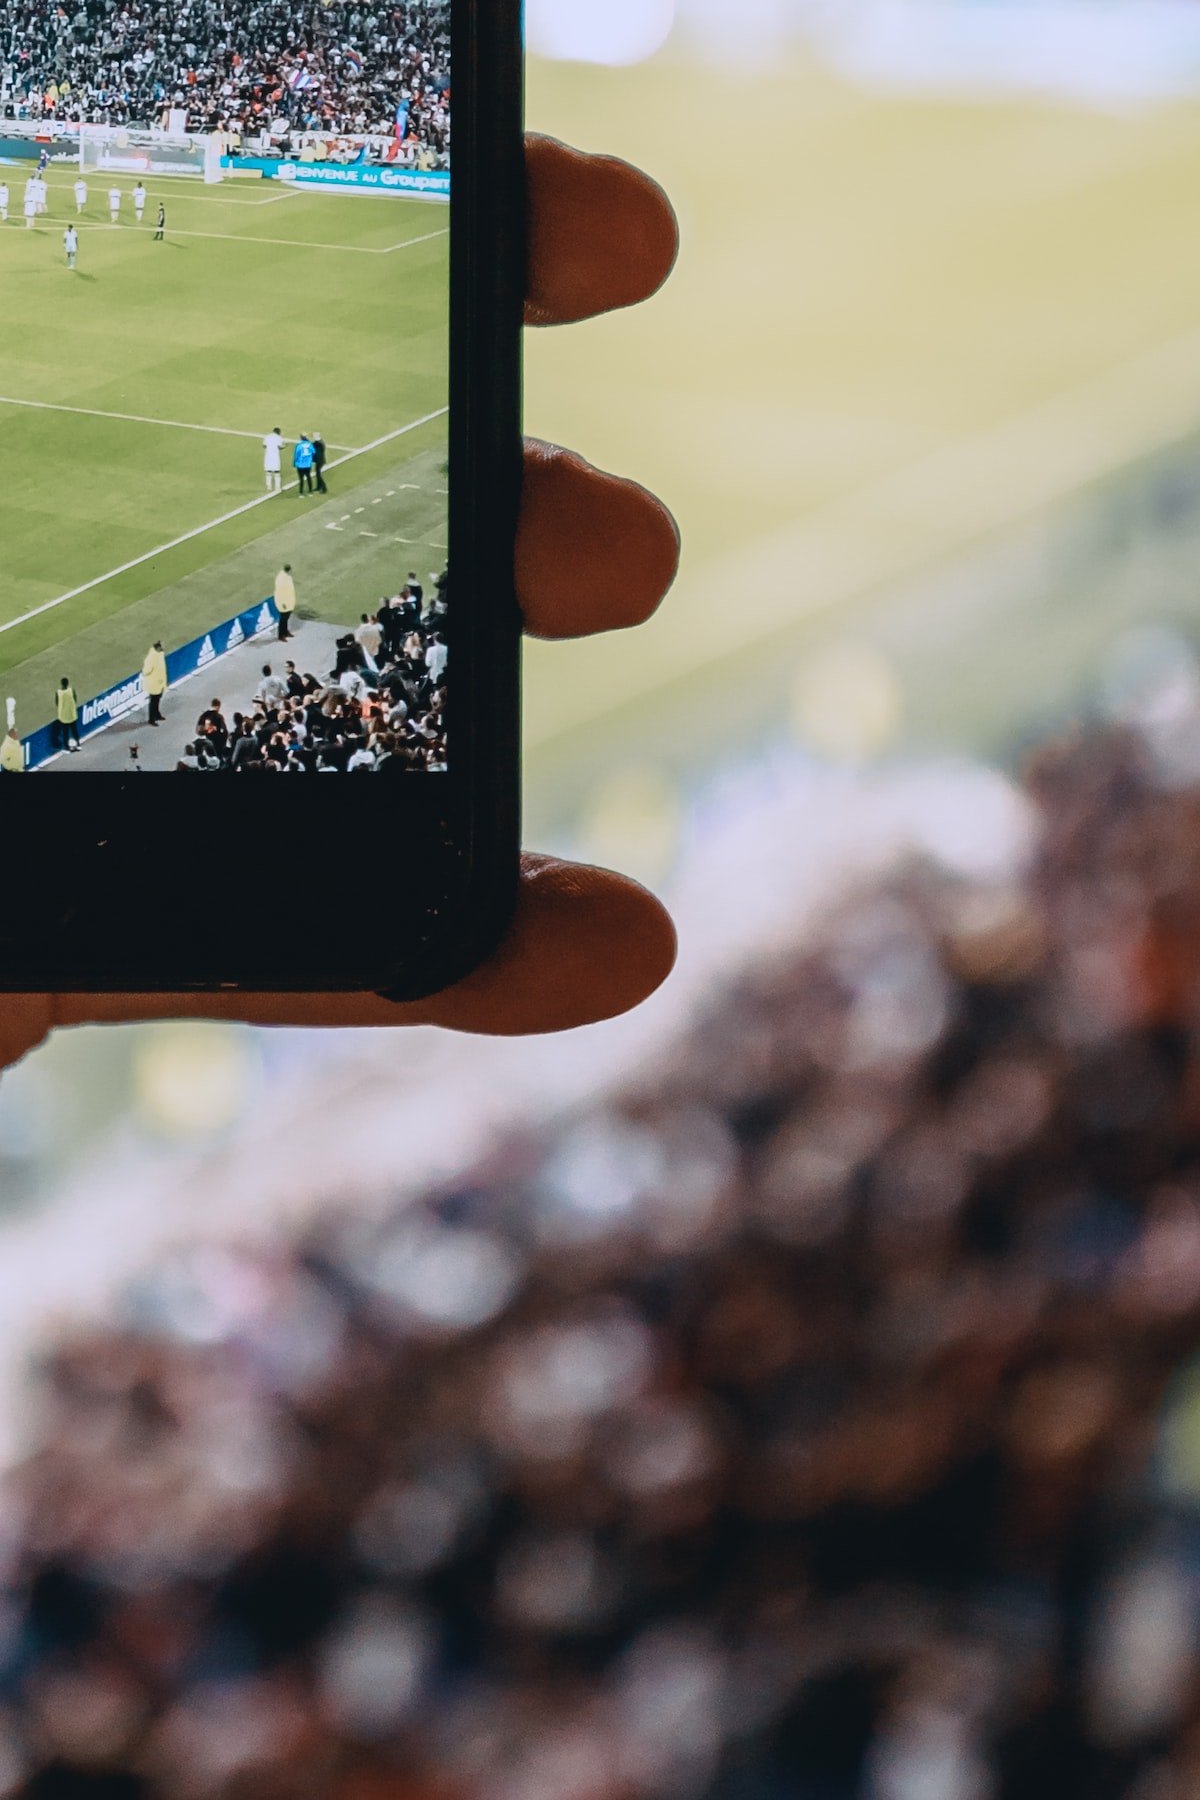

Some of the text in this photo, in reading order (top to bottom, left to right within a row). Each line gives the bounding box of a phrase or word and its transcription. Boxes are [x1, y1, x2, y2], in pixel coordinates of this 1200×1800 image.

[282, 163, 359, 182] BIENVENUE
[362, 174, 378, 184] AU
[82, 673, 144, 726] Intermarc
